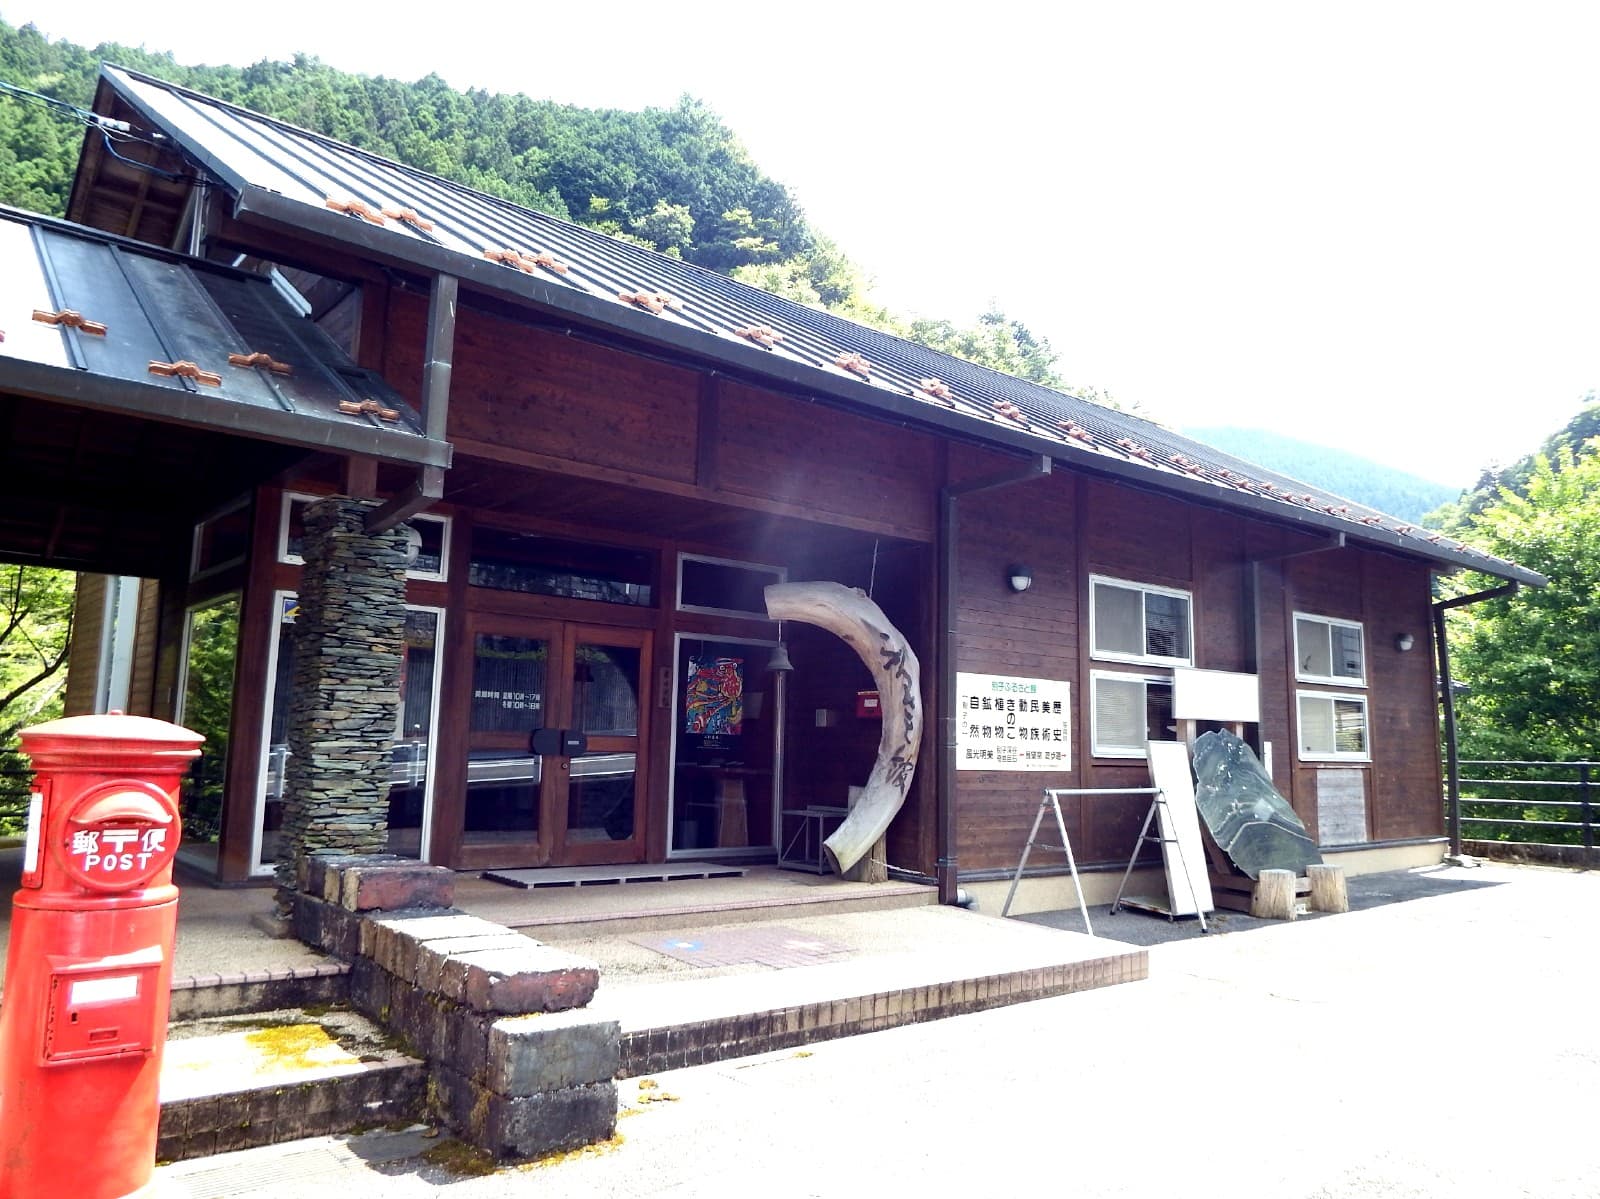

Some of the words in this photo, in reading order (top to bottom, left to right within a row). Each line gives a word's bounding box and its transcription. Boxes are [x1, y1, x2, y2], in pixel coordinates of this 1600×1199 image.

[970, 696, 980, 738] 自然
[994, 698, 1005, 739] 植物
[1006, 699, 1016, 740] きのこ
[1019, 699, 1029, 740] 動物
[1030, 700, 1040, 741] 民族
[1042, 701, 1051, 742] 美術
[1053, 701, 1062, 742] 歴史
[84, 853, 152, 871] POST
